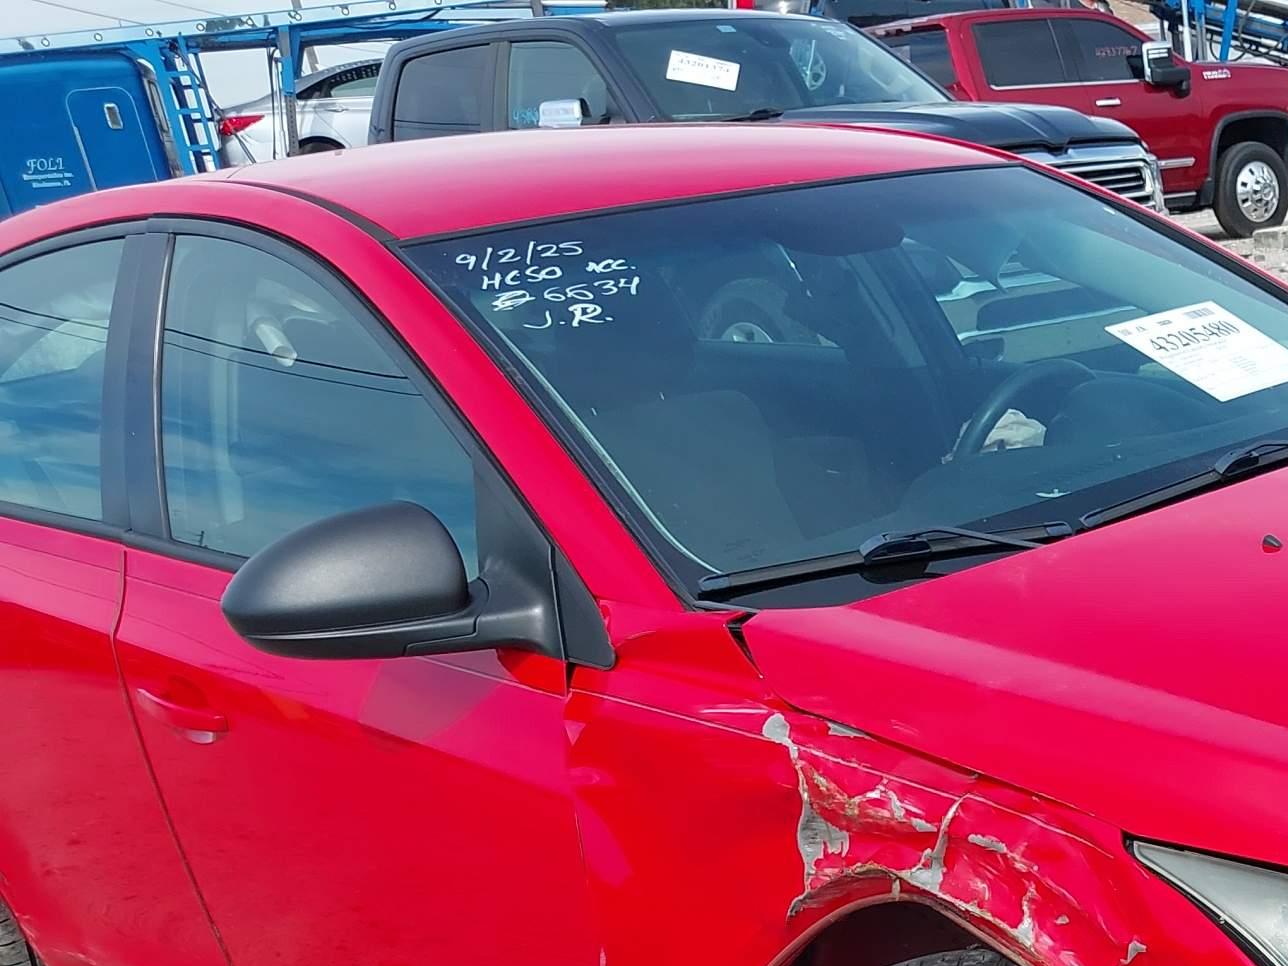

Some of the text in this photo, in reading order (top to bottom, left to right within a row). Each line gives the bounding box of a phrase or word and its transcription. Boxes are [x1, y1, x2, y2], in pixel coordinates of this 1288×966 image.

[26, 157, 64, 174] FOLI
[455, 241, 584, 271] 9/2/25
[1150, 319, 1241, 352] 43205480
